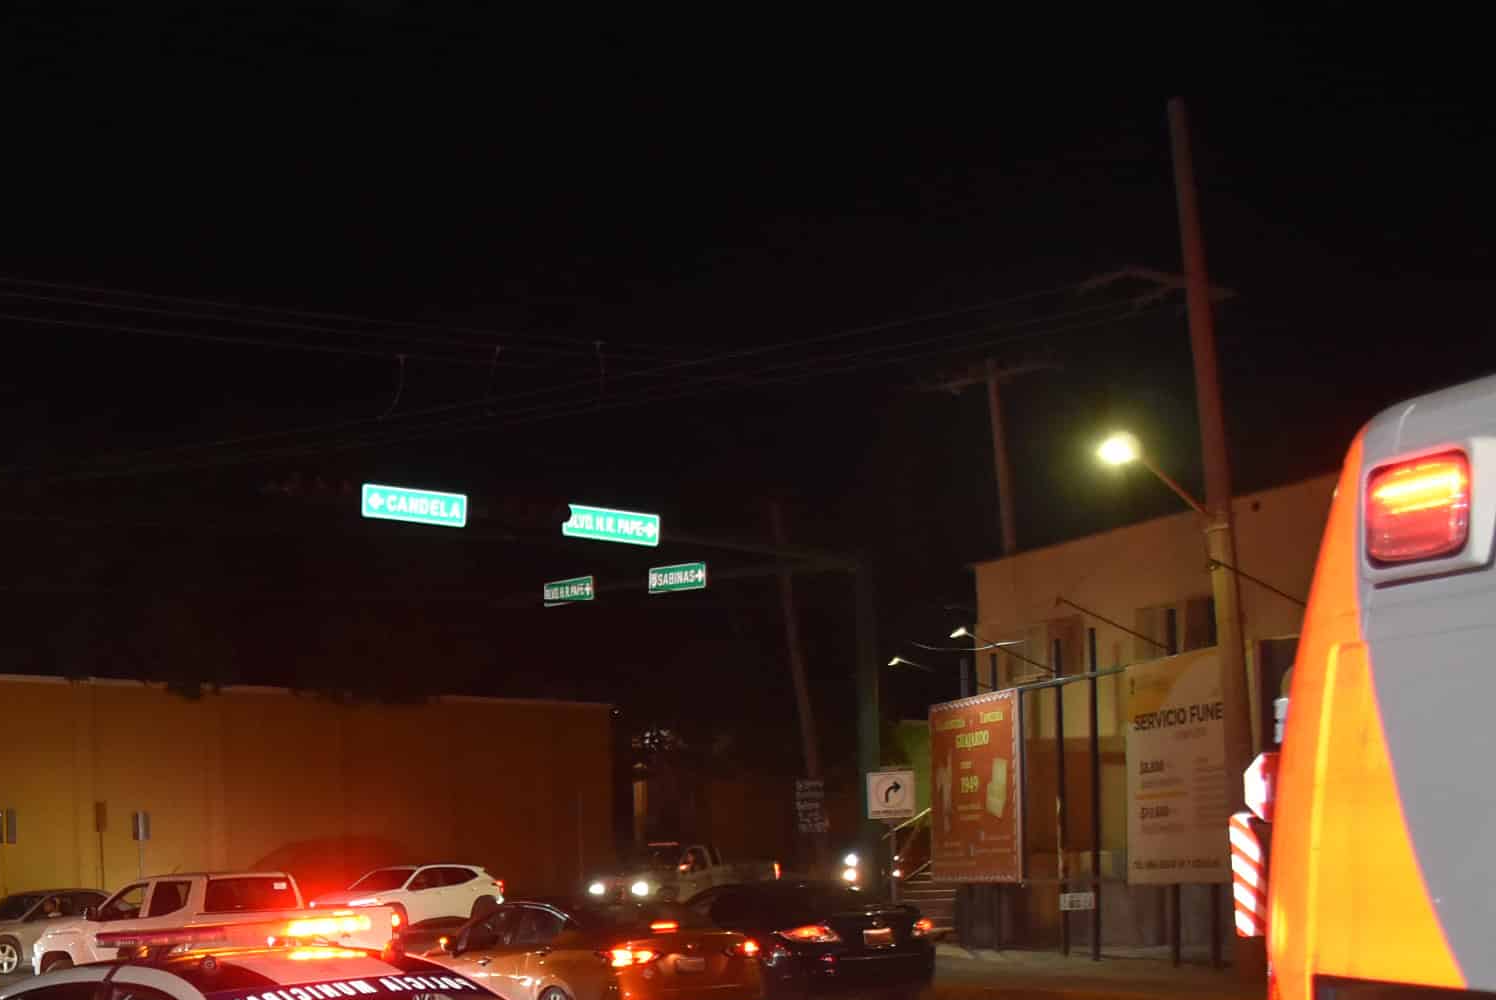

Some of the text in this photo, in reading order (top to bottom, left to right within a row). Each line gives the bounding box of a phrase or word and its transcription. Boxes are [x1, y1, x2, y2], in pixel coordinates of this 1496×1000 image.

[387, 495, 461, 518] CANDELA
[656, 570, 695, 586] SABINAS
[1134, 702, 1224, 730] SERVICIO FUNE
